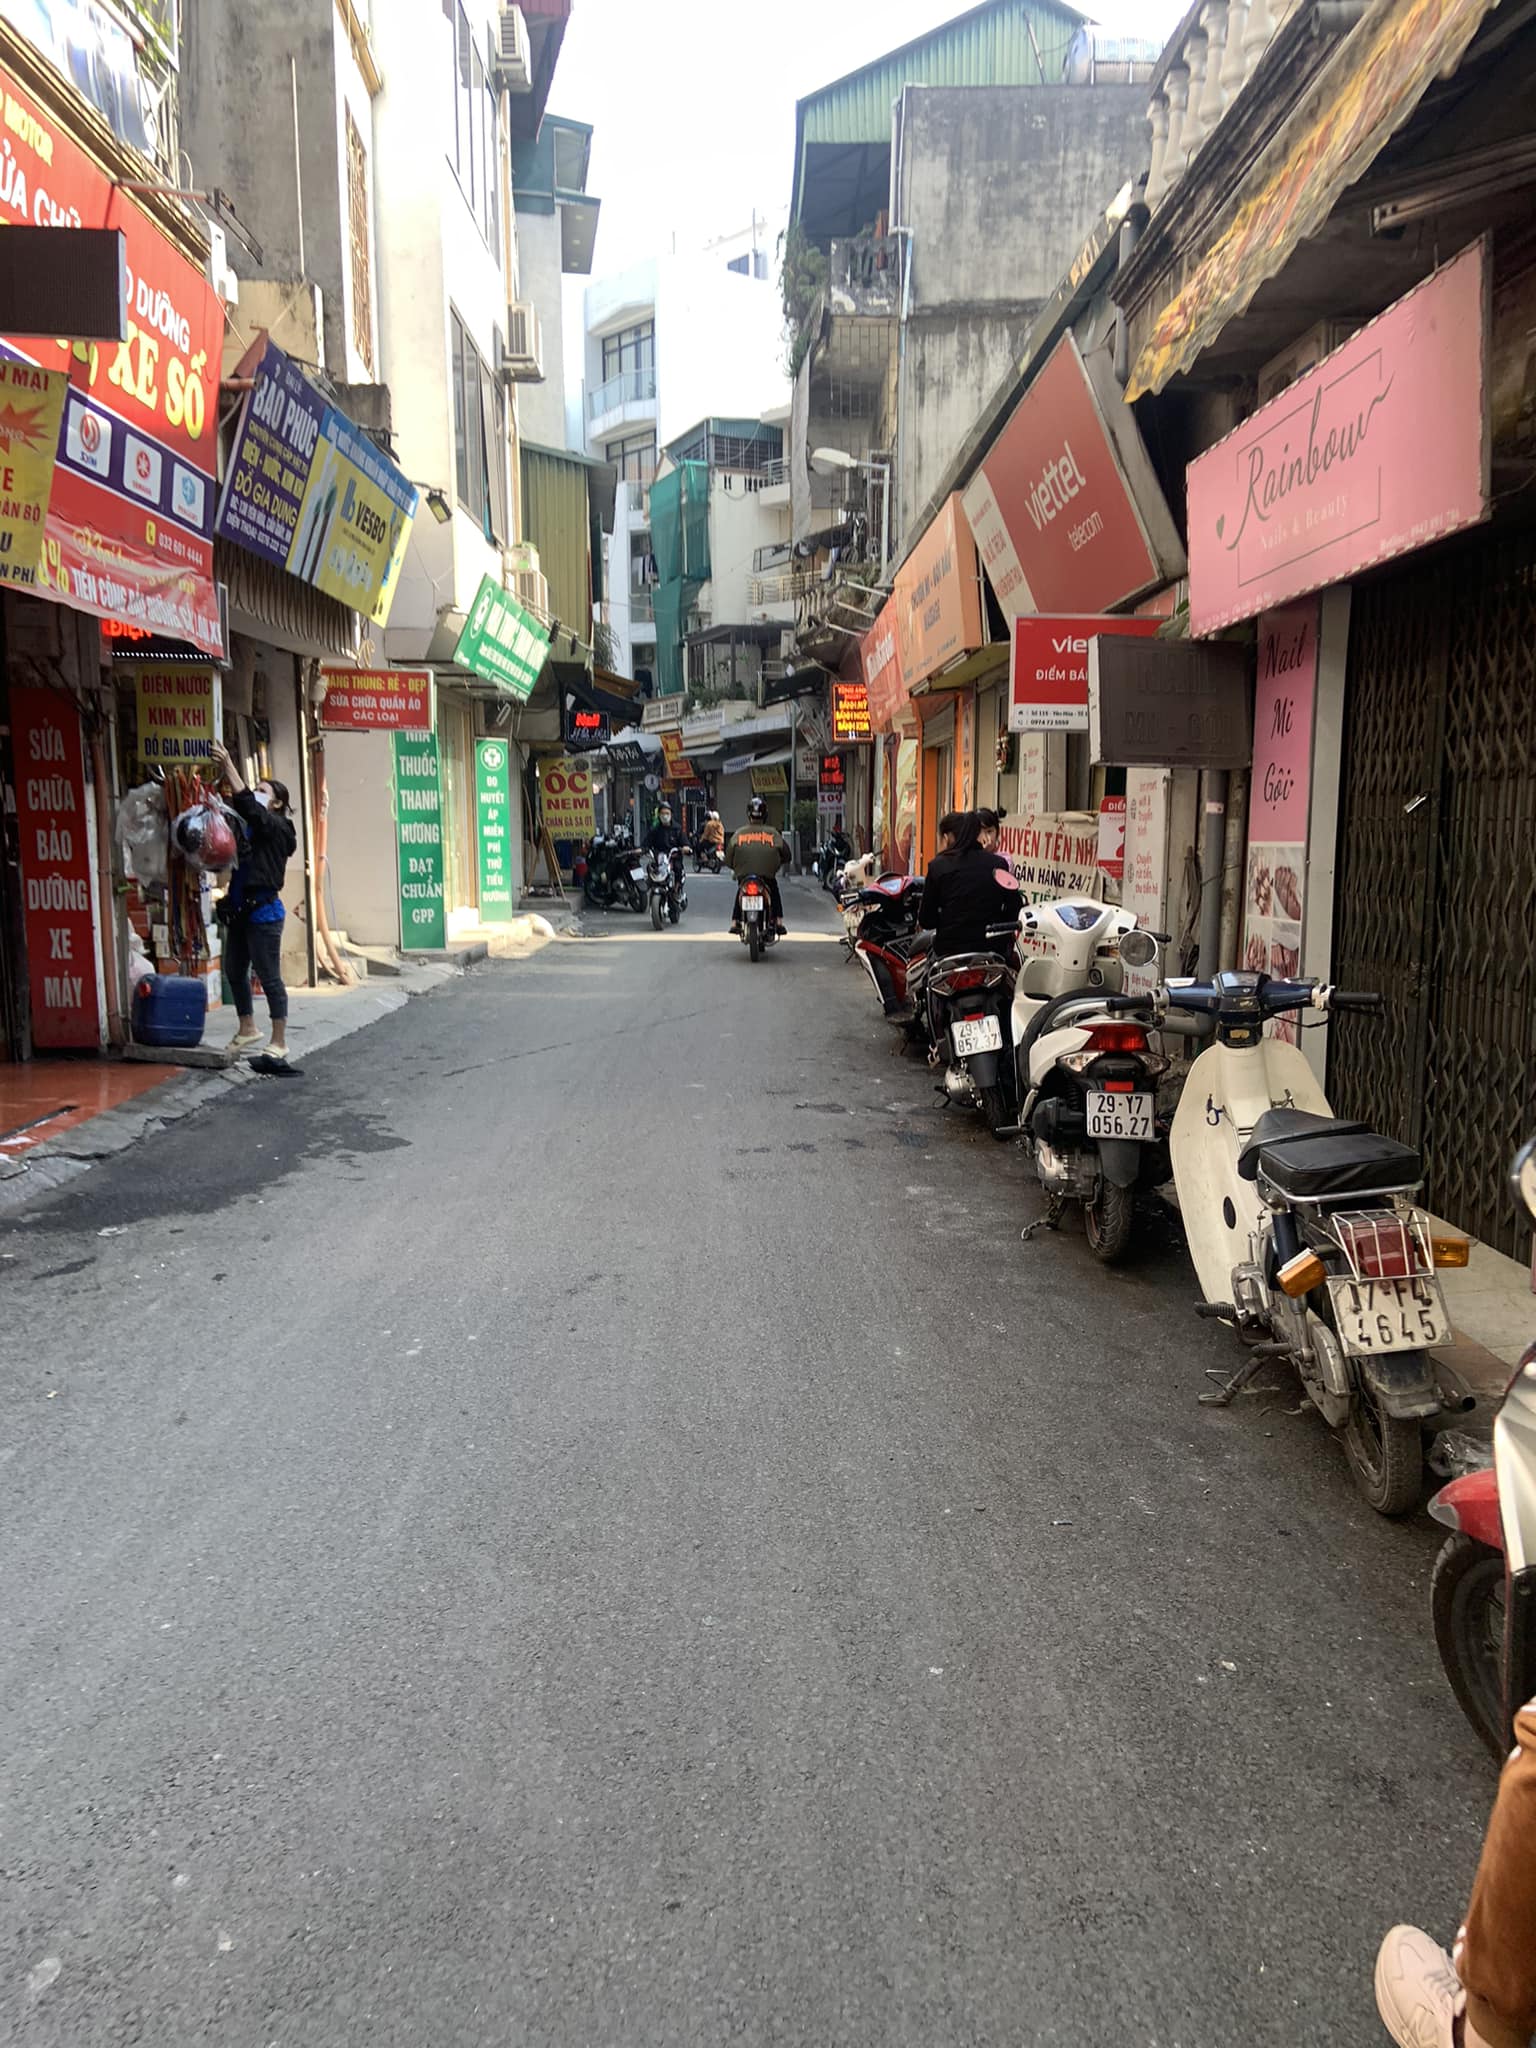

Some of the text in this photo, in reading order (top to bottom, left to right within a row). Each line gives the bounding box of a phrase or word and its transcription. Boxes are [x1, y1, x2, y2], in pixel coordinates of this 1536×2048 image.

[136, 277, 191, 355] DƯỠNG
[12, 368, 49, 394] MẠI
[108, 320, 207, 440] XE SỐ
[252, 363, 318, 459] BẢO PHÚC
[1227, 370, 1396, 551] Rainbow
[253, 483, 270, 511] GIA
[1025, 440, 1086, 531] viettel
[356, 500, 386, 544] VESBO
[1067, 512, 1104, 551] telecom
[12, 565, 36, 584] PHÍ
[1266, 623, 1306, 679] Nail
[176, 672, 210, 696] NƯỚC
[1036, 664, 1065, 681] ĐIỂM
[148, 704, 206, 727] KIM KHÍ
[330, 692, 421, 711] SỬA CHỮA QUẦN ÁO
[353, 710, 399, 724] CÁC LOẠI
[1271, 699, 1294, 740] Mi
[29, 718, 66, 761] SỬA
[162, 738, 180, 756] GIA
[400, 750, 436, 777] THUỐC
[544, 762, 588, 794] ỐC
[27, 774, 76, 811] CHỮA
[400, 789, 438, 811] THANH
[1264, 762, 1295, 811] Gội
[546, 798, 589, 810] NEM
[36, 819, 73, 861] BẢO
[401, 823, 440, 844] HƯƠNG
[409, 858, 434, 876] ĐẠT
[1038, 865, 1065, 888] HÀNG
[27, 872, 89, 911] DƯỠNG
[402, 876, 443, 899] CHUẨN
[412, 908, 435, 924] GPP
[49, 928, 72, 959] XE
[44, 971, 83, 1008] MÁY
[1092, 1116, 1149, 1137] 056.27
[1358, 1309, 1437, 1347] 4645
